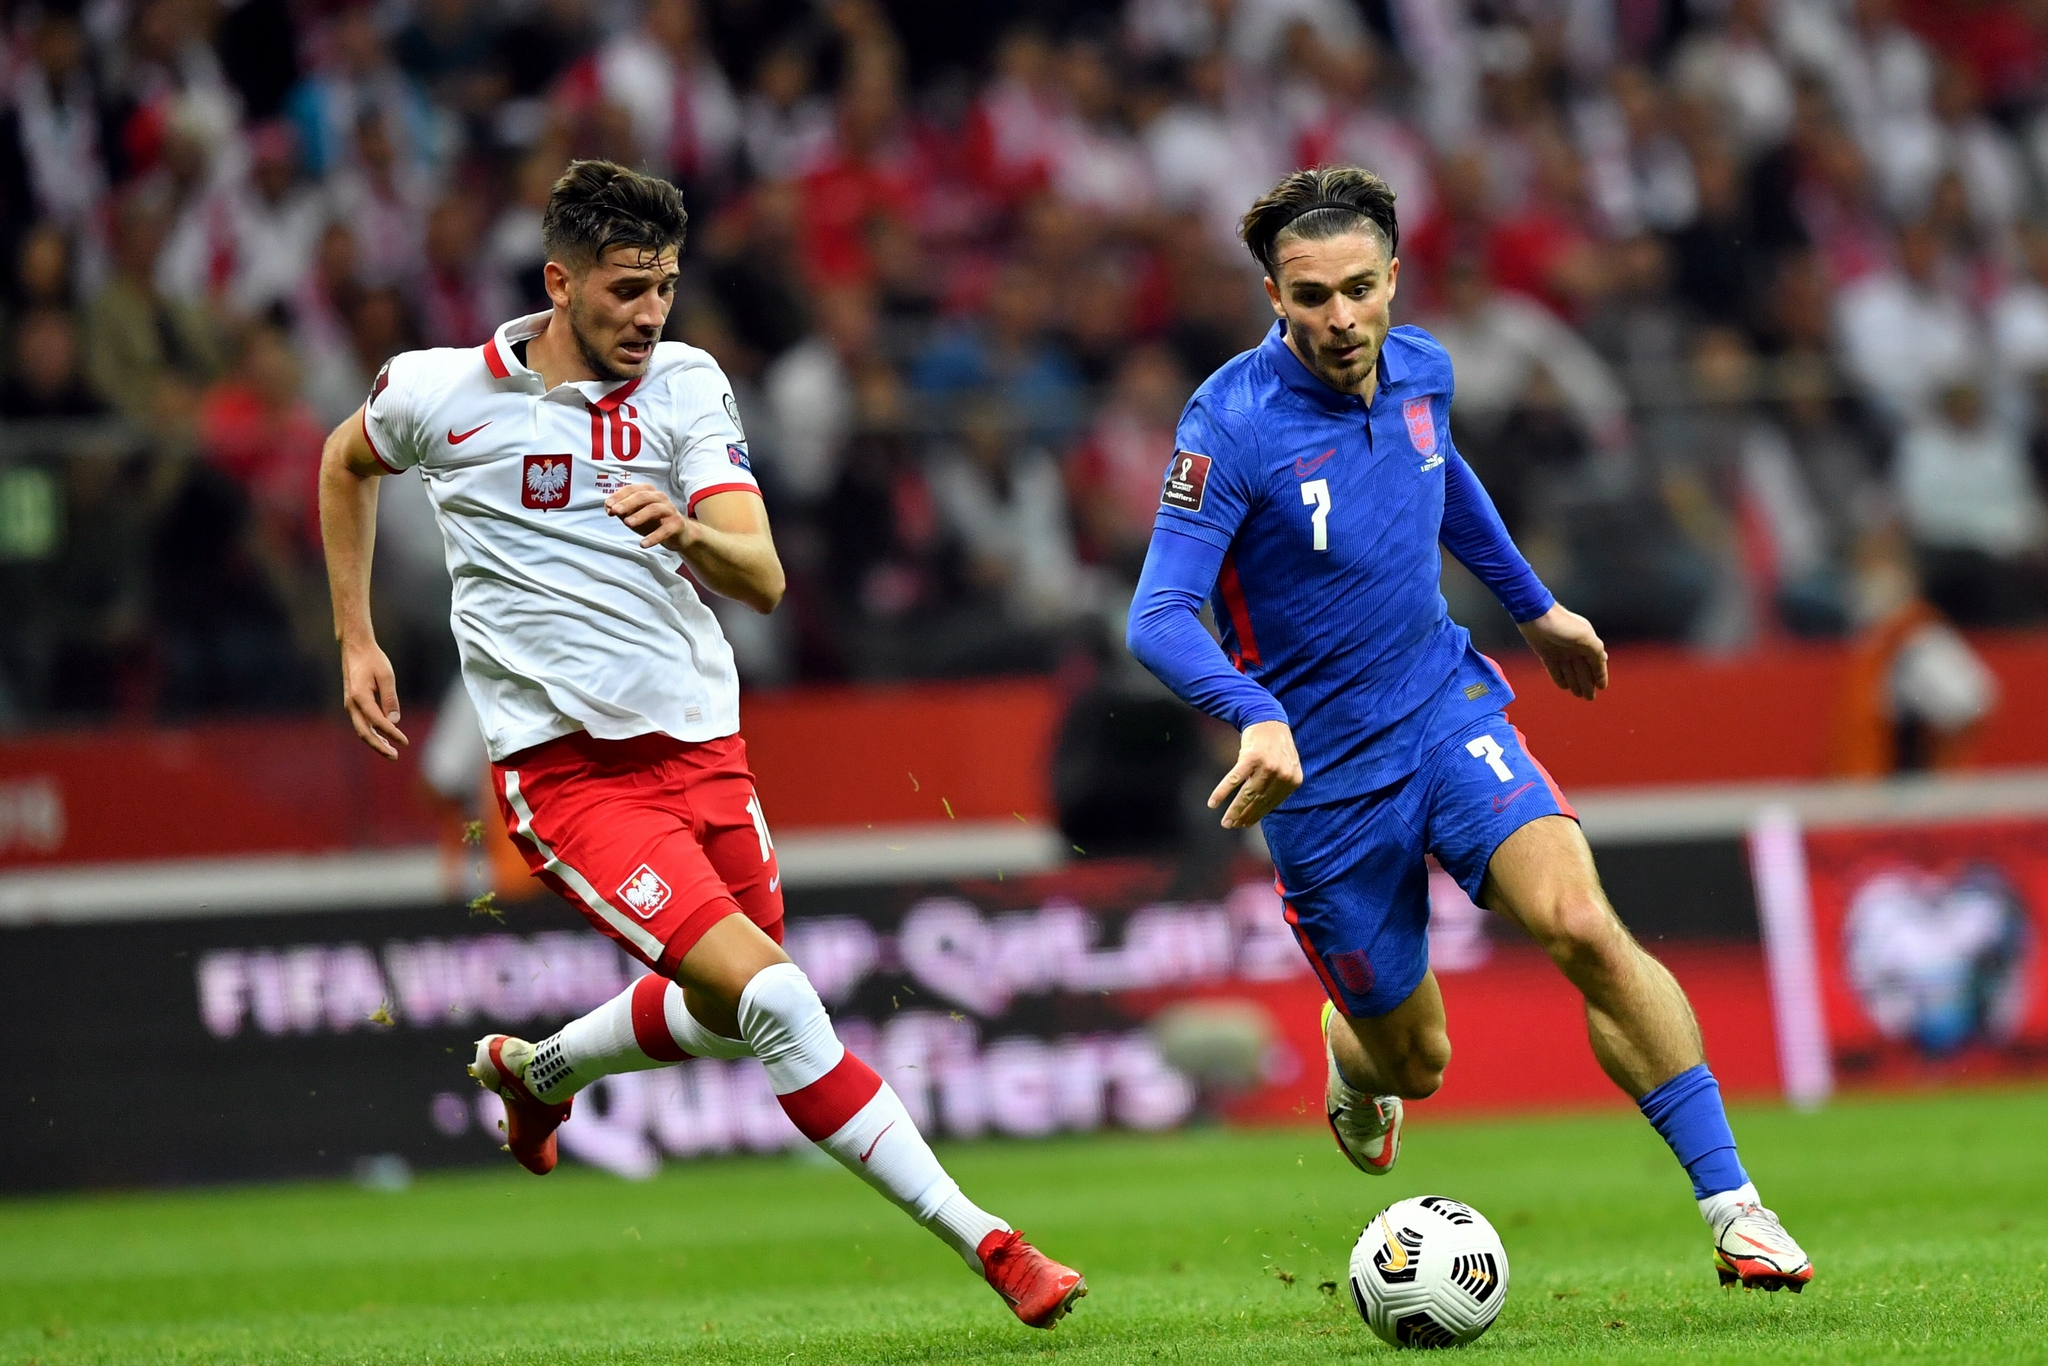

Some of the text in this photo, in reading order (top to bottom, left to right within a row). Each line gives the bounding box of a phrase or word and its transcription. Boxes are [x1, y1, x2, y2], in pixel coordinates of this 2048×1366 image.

[584, 401, 642, 461] 16
[1300, 478, 1331, 550] 7
[1464, 734, 1515, 783] 7
[745, 785, 775, 863] 1
[197, 943, 390, 1037] FIFA
[384, 930, 655, 1028] WORL
[476, 1010, 1195, 1182] Quafiers
